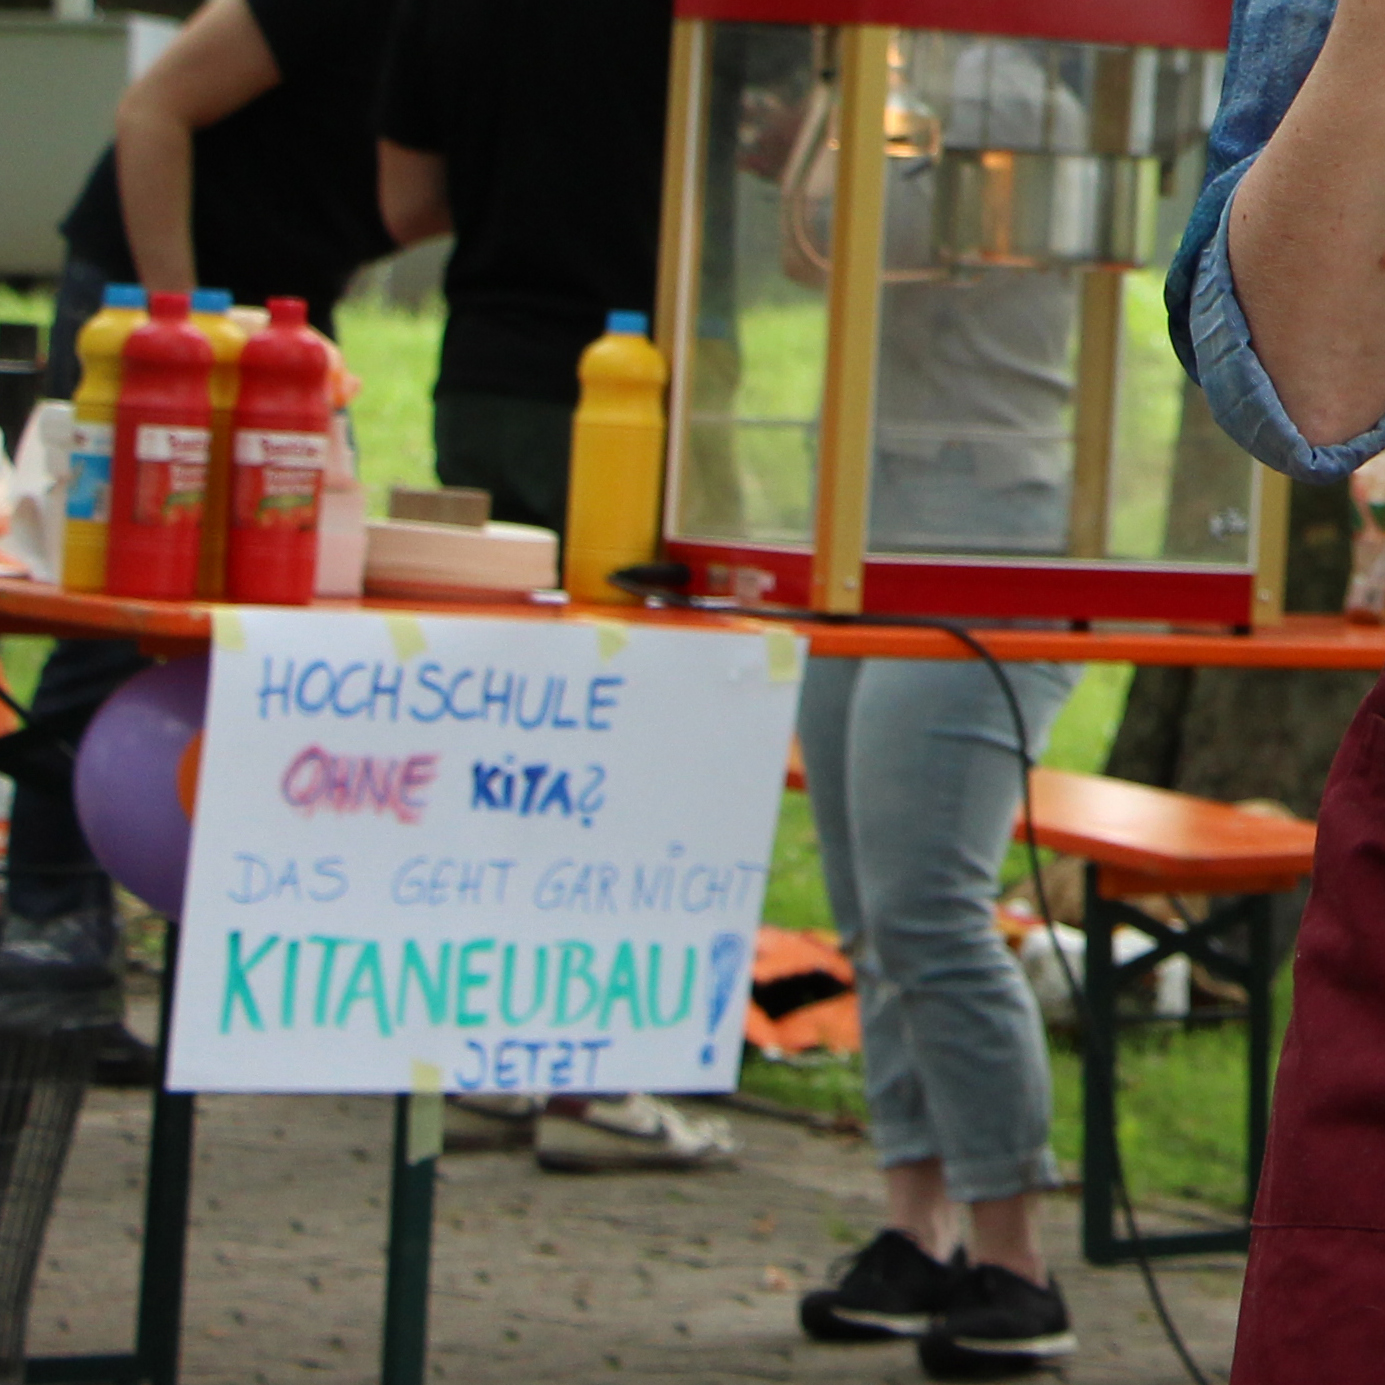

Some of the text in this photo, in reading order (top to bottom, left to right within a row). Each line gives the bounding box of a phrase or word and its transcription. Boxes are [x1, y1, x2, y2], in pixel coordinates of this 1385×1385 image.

[258, 654, 626, 732] HOCHSCHULE
[281, 742, 441, 825] OHNE
[226, 851, 350, 906] DAS
[390, 854, 518, 908] GEHT
[454, 1037, 613, 1092] JETZT
